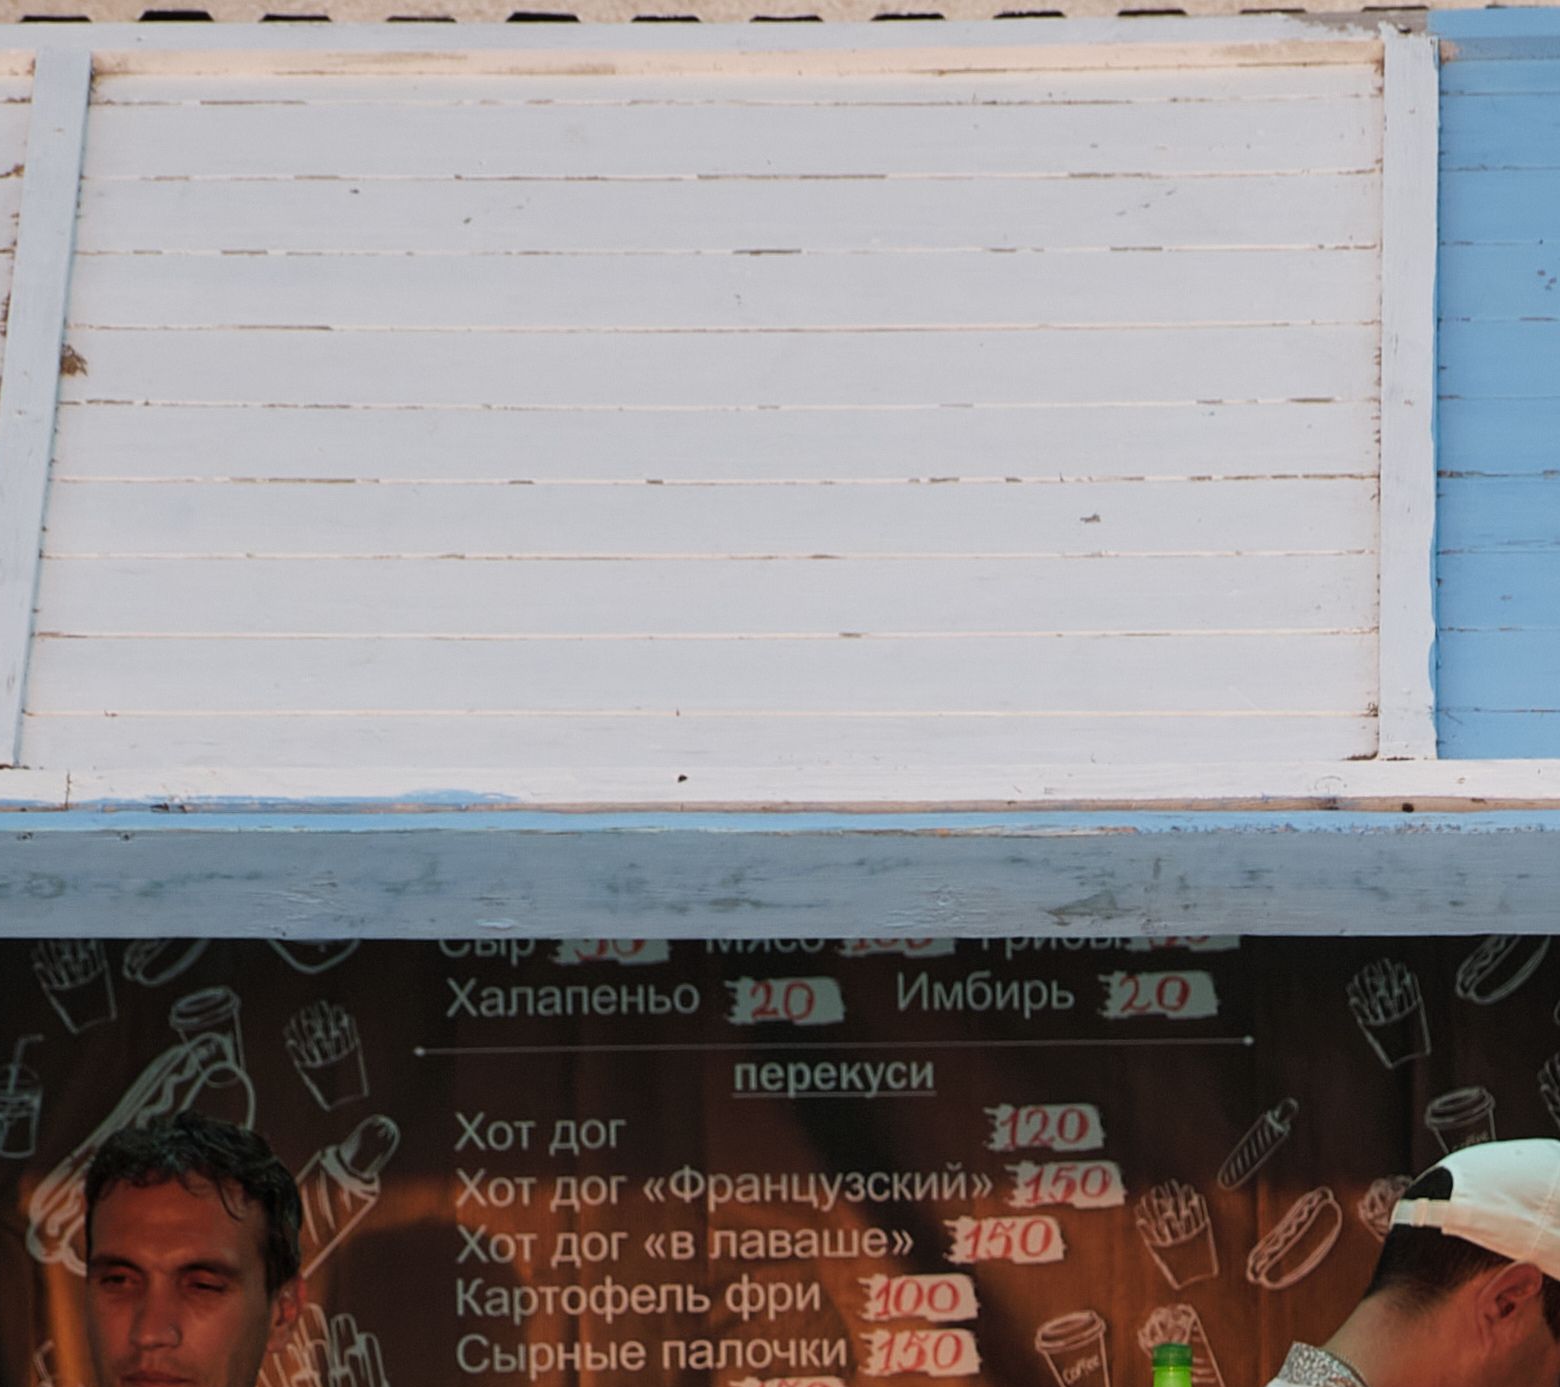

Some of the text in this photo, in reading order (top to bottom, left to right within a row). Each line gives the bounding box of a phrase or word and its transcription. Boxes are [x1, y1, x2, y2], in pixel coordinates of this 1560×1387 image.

[446, 971, 1191, 1021] Халапеньо 20 Имбирь 20
[733, 1061, 935, 1095] перекуси
[456, 1108, 1090, 1157] Хот дог 120
[456, 1165, 1113, 1212] Хот дог «Французский» 150
[456, 1220, 1052, 1268] Хот дог «в лаваше» 150
[455, 1276, 962, 1324] Картофель фри 100
[456, 1334, 963, 1381] Сырные палочки 150
